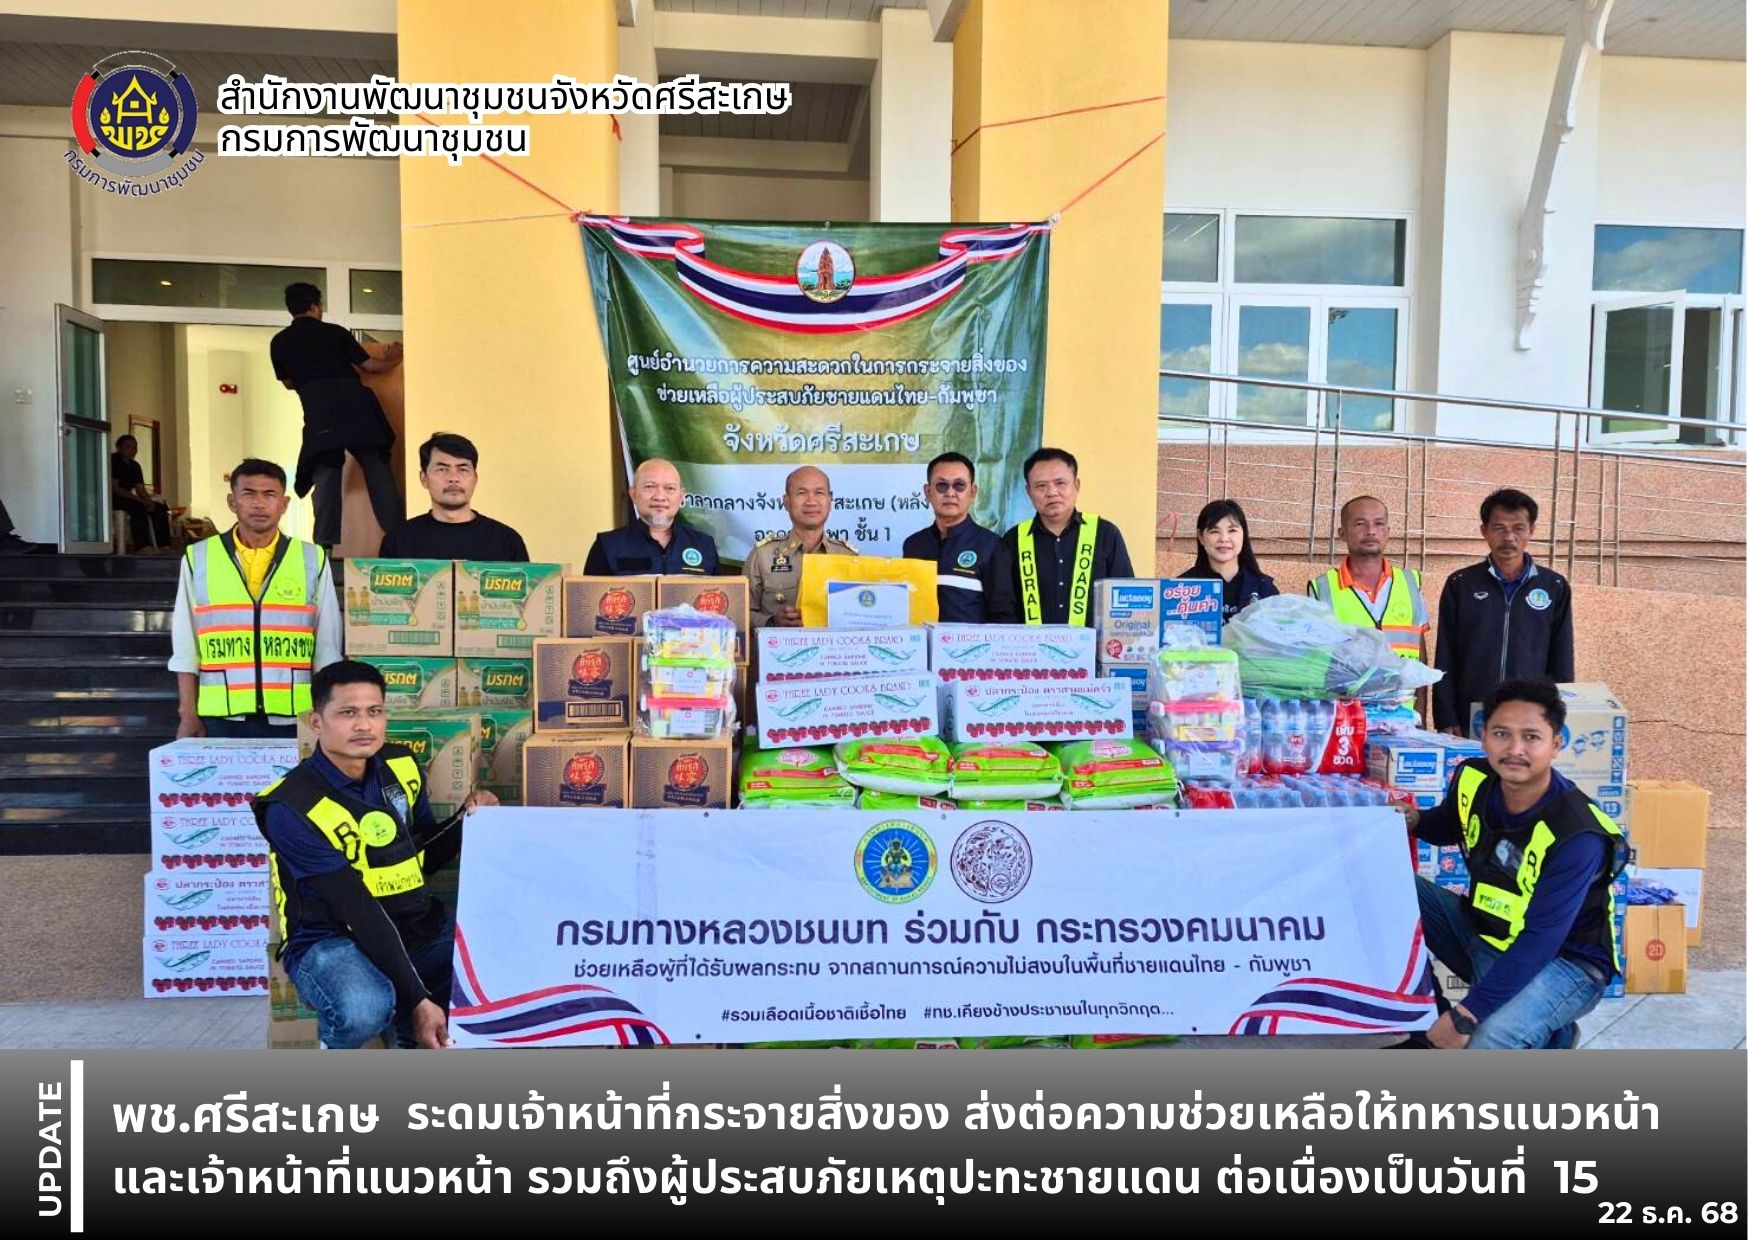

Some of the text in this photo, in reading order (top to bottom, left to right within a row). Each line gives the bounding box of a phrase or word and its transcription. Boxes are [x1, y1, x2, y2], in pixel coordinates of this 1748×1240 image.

[627, 349, 1028, 376] ศูนย์อำนวยการความสะดวกในการกระจายสิ่งของ
[723, 423, 920, 454] จังหวัดศรีสะเกษ
[854, 517, 878, 542] ชั้น
[884, 527, 891, 541] 1
[1021, 551, 1038, 620] RURAL
[1073, 544, 1092, 614] ROADS
[1114, 620, 1151, 632] Original
[814, 688, 837, 697] LADY
[1339, 736, 1349, 755] 3
[210, 756, 235, 764] LADY
[212, 817, 238, 825] LADY
[556, 910, 1326, 946] กรมทางหลวงชนบท ร่วมกับ กระทรวงคมนาคม
[203, 940, 229, 949] LADY
[574, 953, 820, 982] ช่วยเหลือผู้ที่ได้รับผลกระทบ
[829, 952, 1225, 976] จากสถานการณ์ความไม่สงบในพื้นที่ชายแดนไทย
[1249, 954, 1311, 977] กัมพูชา
[722, 1000, 1174, 1022] #รวมเลือดเนื้อชาติเชื้อไทย #ทช.เคียงข้างประชาชนในทุกวิกฤต...
